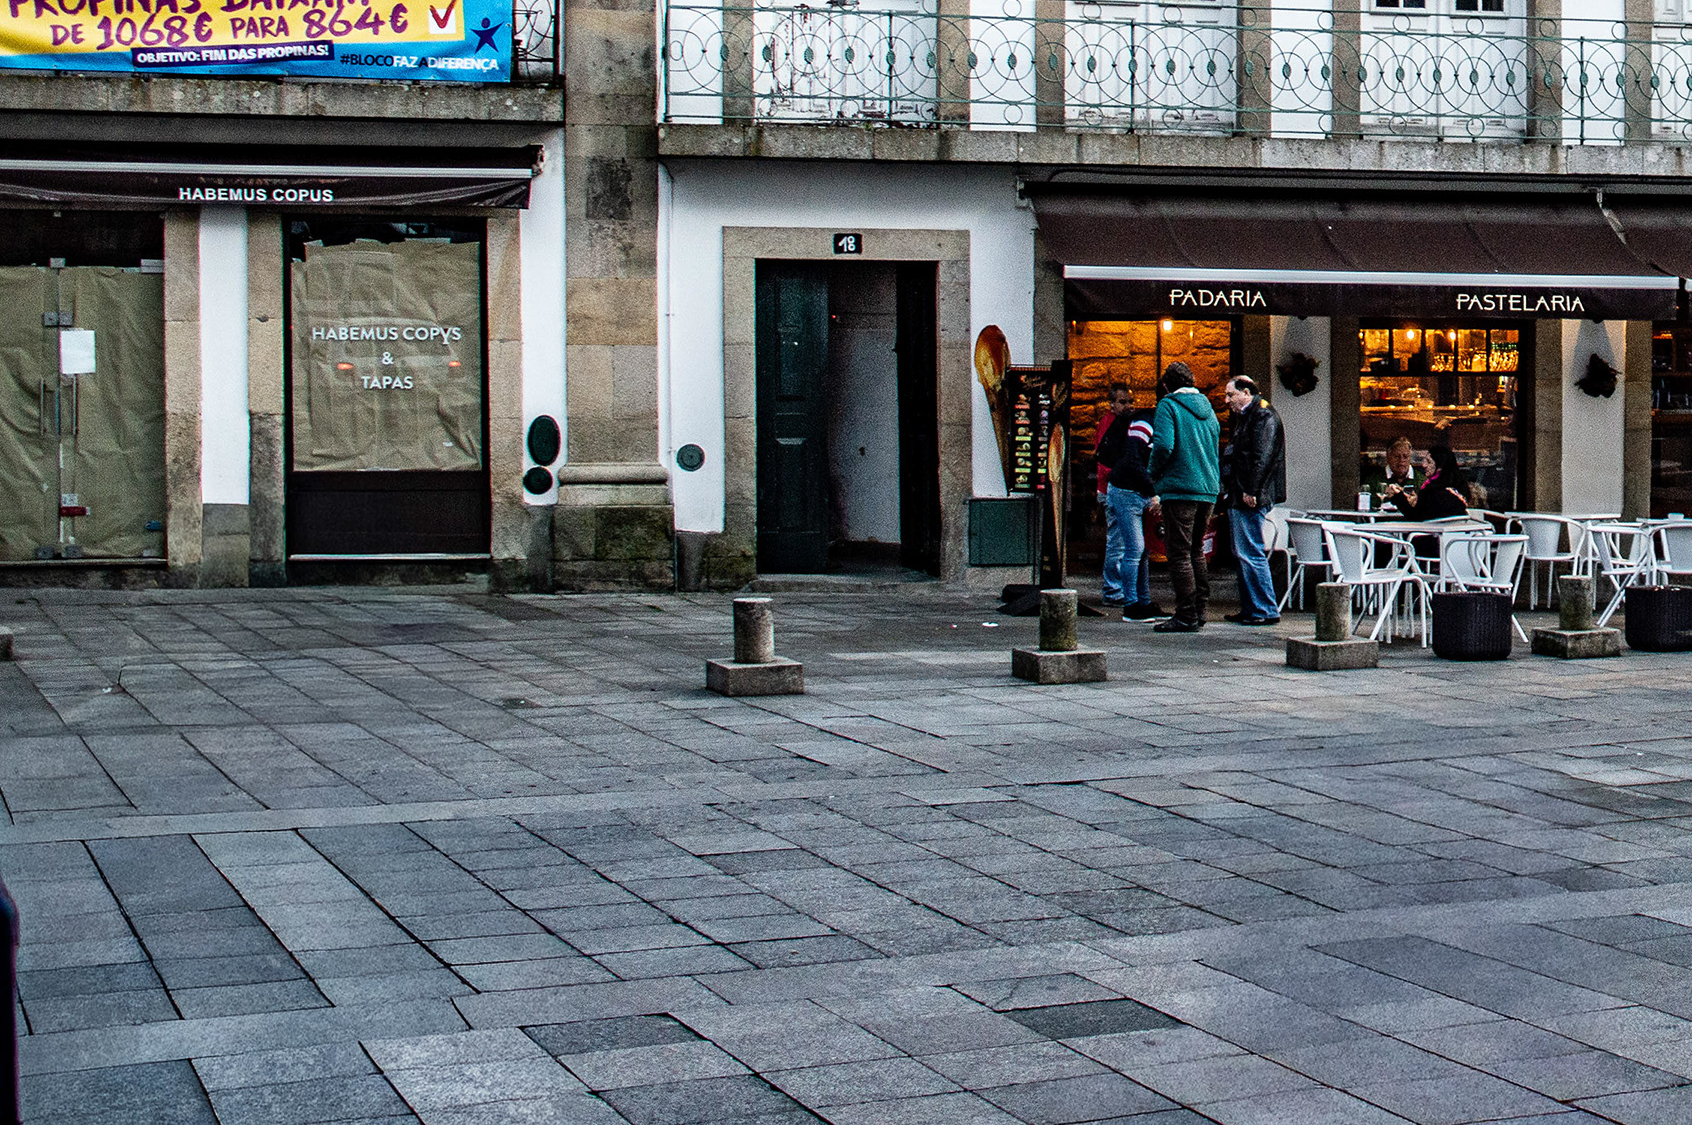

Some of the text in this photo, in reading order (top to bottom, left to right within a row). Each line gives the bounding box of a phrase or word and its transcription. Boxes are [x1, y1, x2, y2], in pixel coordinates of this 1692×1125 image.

[50, 3, 409, 51] DE 1068€ PARA 864€
[137, 44, 330, 64] OBJETIVO: FIM DAS PROPINAS!
[178, 187, 335, 203] HABEMUS COPUS
[838, 235, 856, 252] 18
[1168, 289, 1267, 307] PADARIA
[1456, 293, 1585, 312] PASTELARIA
[311, 326, 399, 341] HABEMUS
[381, 351, 394, 365] &
[361, 375, 414, 390] TAPAS
